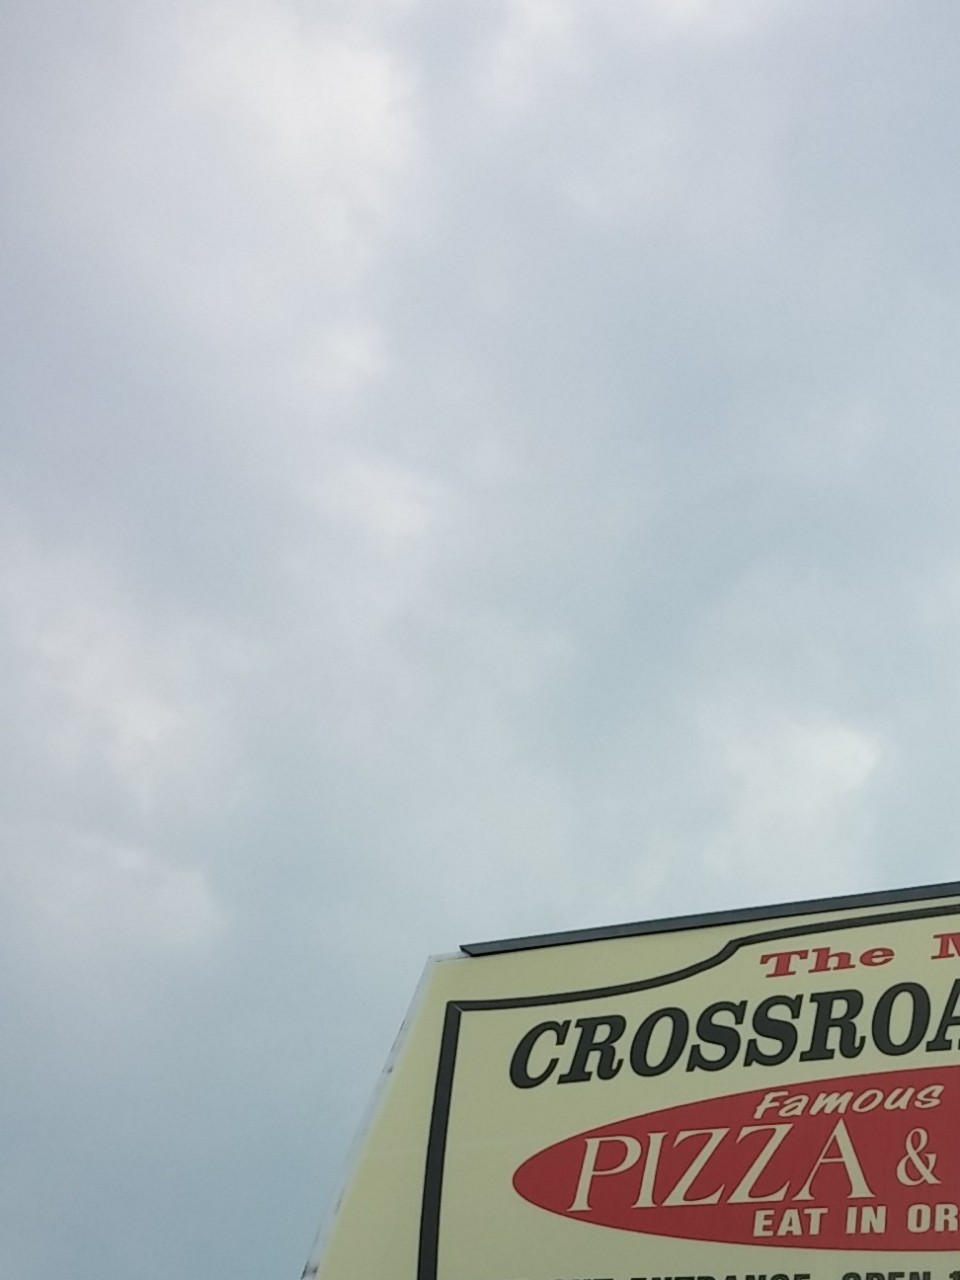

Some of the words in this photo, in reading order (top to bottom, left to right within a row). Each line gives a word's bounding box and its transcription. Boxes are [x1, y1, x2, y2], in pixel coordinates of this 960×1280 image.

[760, 945, 895, 978] The
[752, 1083, 946, 1120] Famous
[567, 1117, 876, 1213] PIZZA
[896, 1128, 942, 1187] &
[752, 1207, 829, 1238] EAT
[845, 1206, 887, 1235] IN
[906, 1202, 960, 1234] OR
